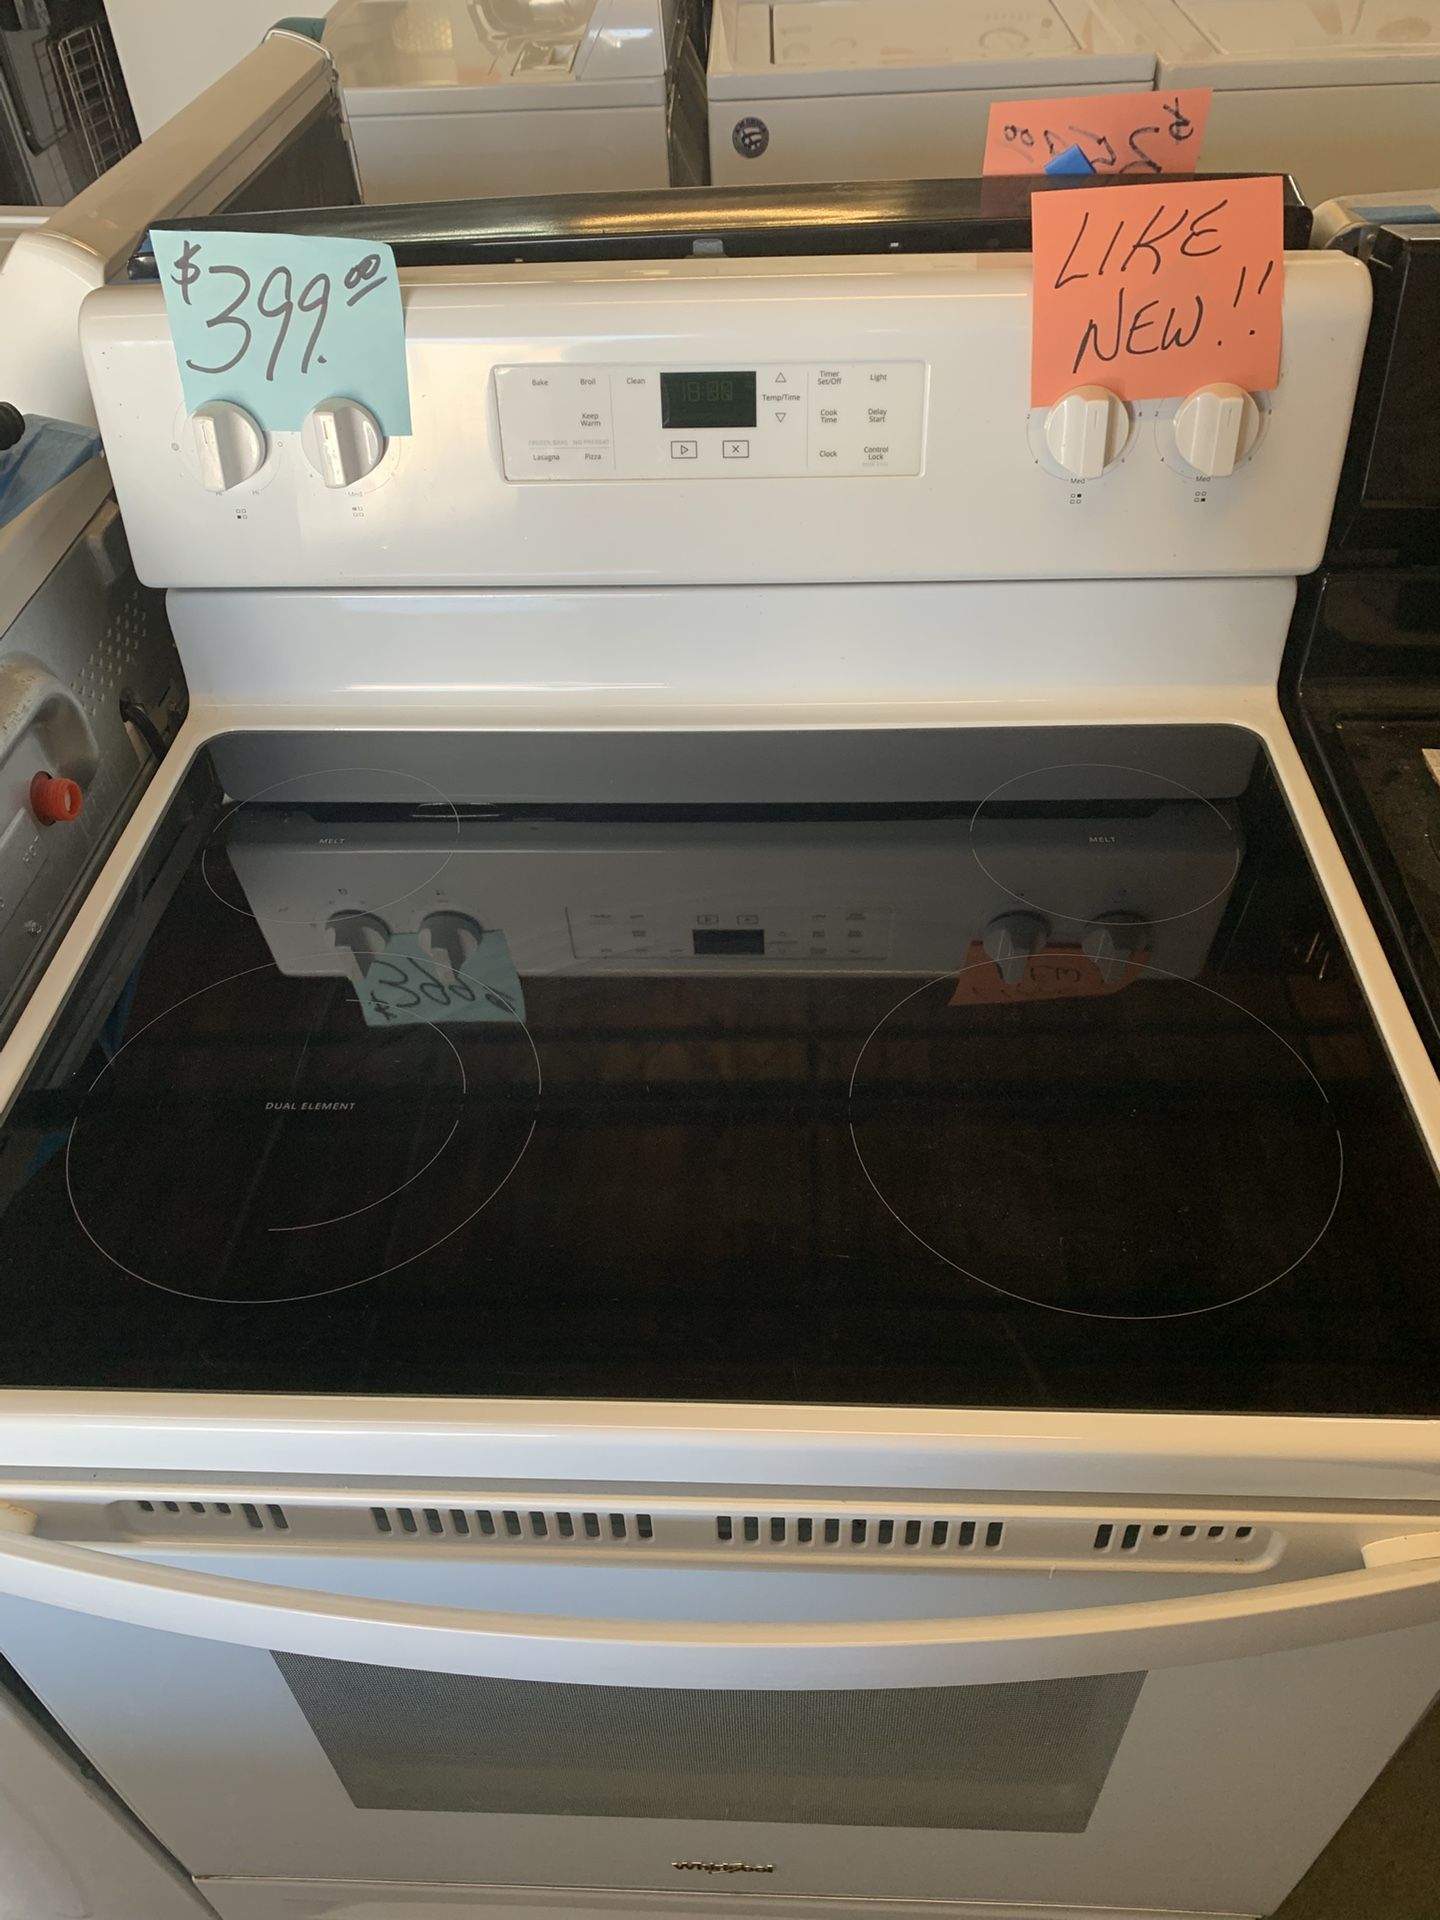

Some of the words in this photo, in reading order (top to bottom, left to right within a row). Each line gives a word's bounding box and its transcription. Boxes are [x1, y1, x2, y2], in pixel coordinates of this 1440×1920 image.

[1054, 199, 1228, 290] LIKE
[819, 370, 840, 378] Timer
[869, 373, 888, 383] Light
[531, 378, 549, 387] Bake
[579, 377, 597, 386] Broil
[626, 376, 646, 385] Clean
[817, 377, 842, 386] Set/Off
[761, 393, 801, 402] Temp/Time
[581, 412, 599, 421] Keep
[820, 408, 838, 417] Cook
[867, 407, 888, 417] Delay
[820, 416, 838, 424] Time
[868, 415, 886, 424] Start
[819, 450, 838, 458] Clock
[863, 445, 889, 454] Control
[532, 453, 561, 463] Lasagna
[584, 452, 602, 461] Pizza
[868, 453, 884, 461] Lock
[319, 837, 346, 845] MELT
[264, 1101, 297, 1111] DUAL
[300, 1101, 357, 1111] ELEMENT
[671, 1861, 775, 1875] Whirlpool
